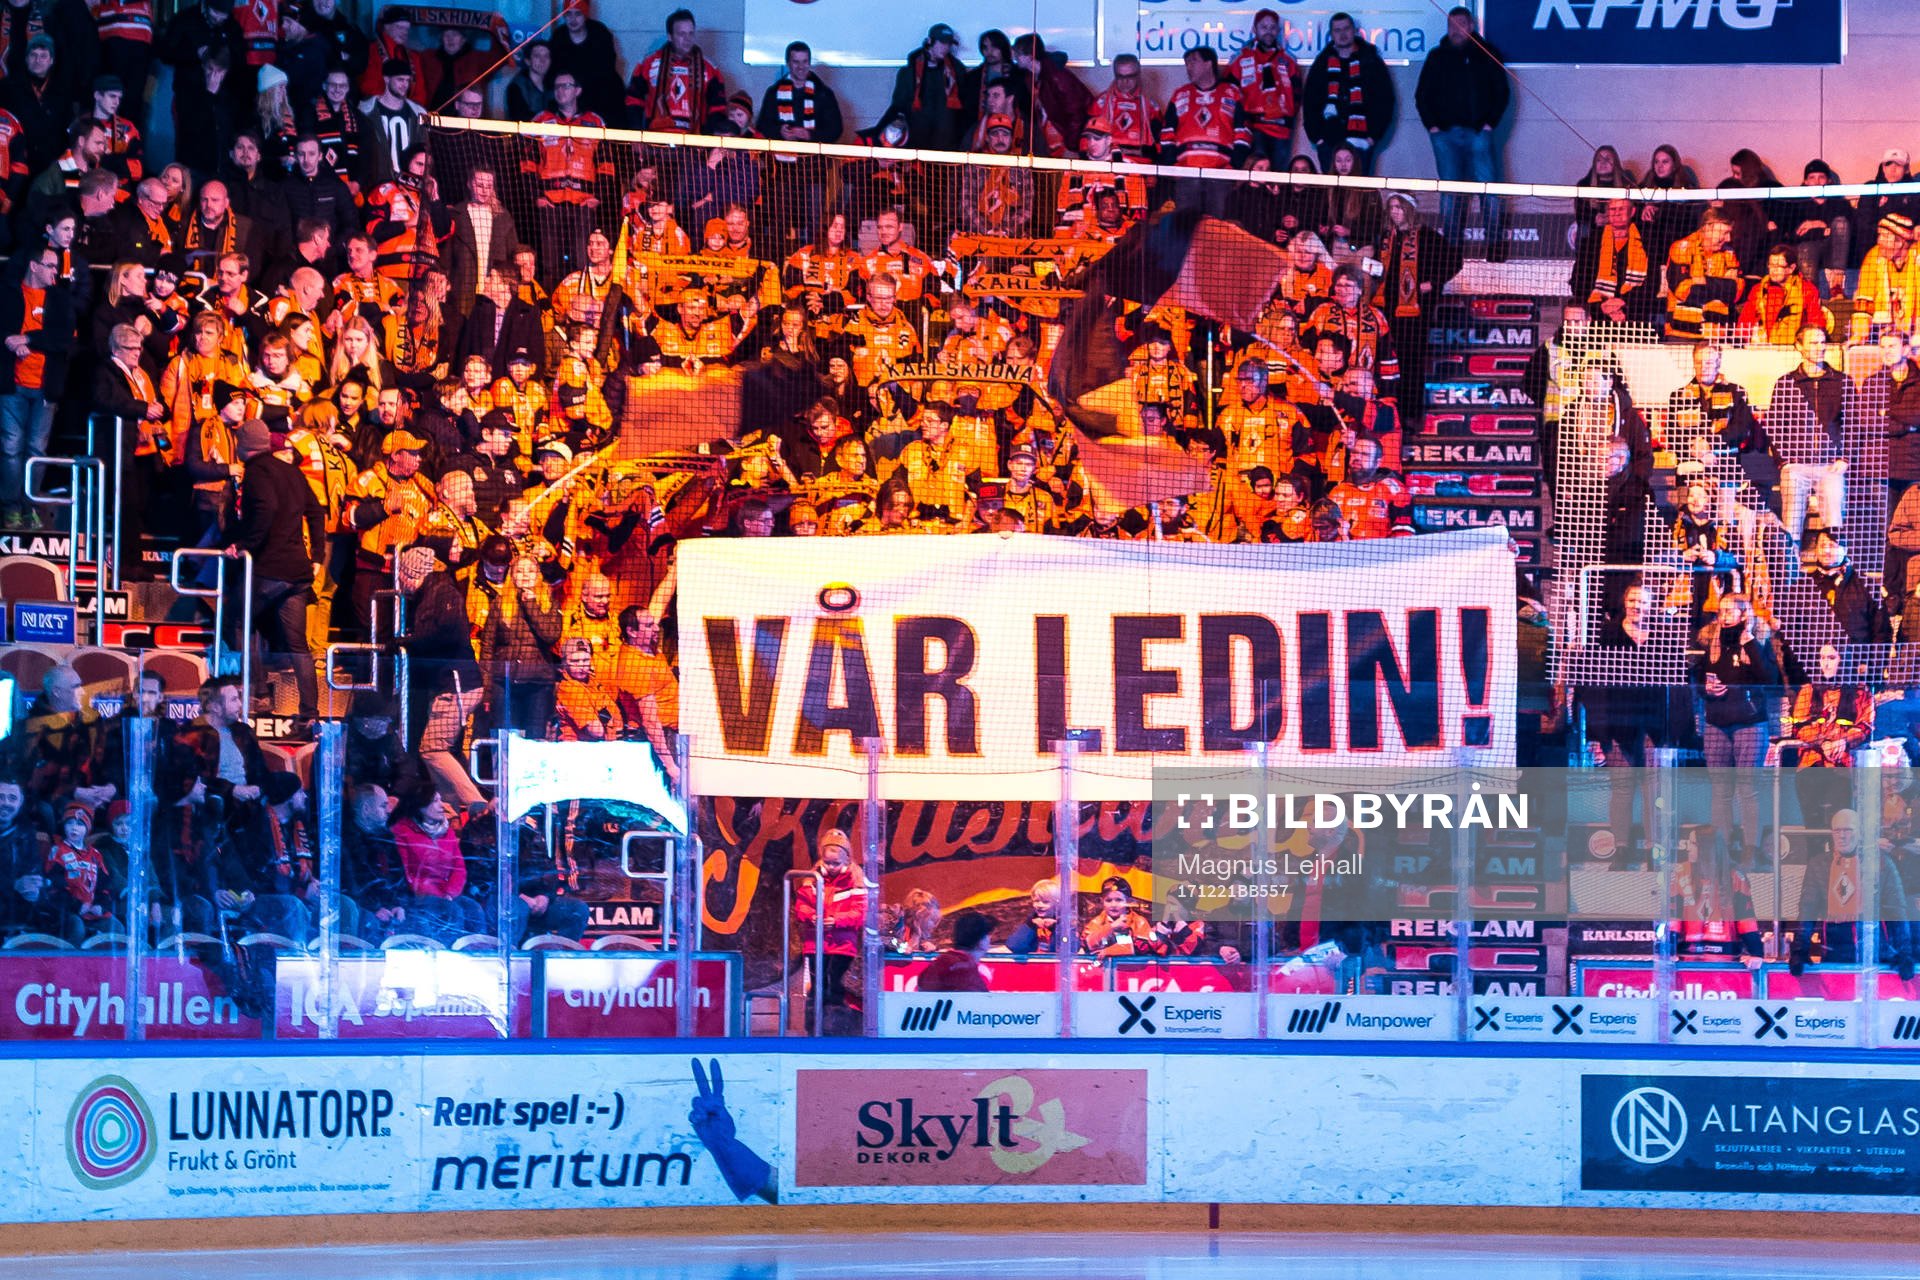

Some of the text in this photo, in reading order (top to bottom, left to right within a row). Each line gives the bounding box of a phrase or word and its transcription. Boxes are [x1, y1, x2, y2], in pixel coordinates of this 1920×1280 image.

[1428, 328, 1532, 344] EKLAM
[886, 361, 1034, 382] KARLSKRONA
[1433, 388, 1534, 404] EKLAM
[1426, 509, 1535, 526] EKLAM
[22, 612, 68, 629] NKT
[702, 580, 1495, 758] VÅR LEDIN!
[587, 907, 654, 925] KLAM
[1391, 981, 1536, 997] REKAM
[15, 982, 239, 1036] Cityhallen
[1164, 1005, 1223, 1023] Experis
[957, 1010, 1041, 1028] Manpower
[1346, 1012, 1433, 1030] Manpower
[1590, 1012, 1638, 1026] Experis
[1703, 1015, 1741, 1026] Experis
[1795, 1014, 1846, 1030] Experis
[169, 1088, 393, 1141] LUNNATORP
[433, 1092, 625, 1132] Rent spel :-)
[1701, 1104, 1920, 1136] ALTANGLAS
[857, 1098, 1020, 1161] Skylt
[169, 1149, 297, 1171] Frukt & Grönt
[857, 1152, 931, 1164] DEKOR
[1866, 1147, 1906, 1156] UTERUM
[432, 1152, 693, 1191] meritum
